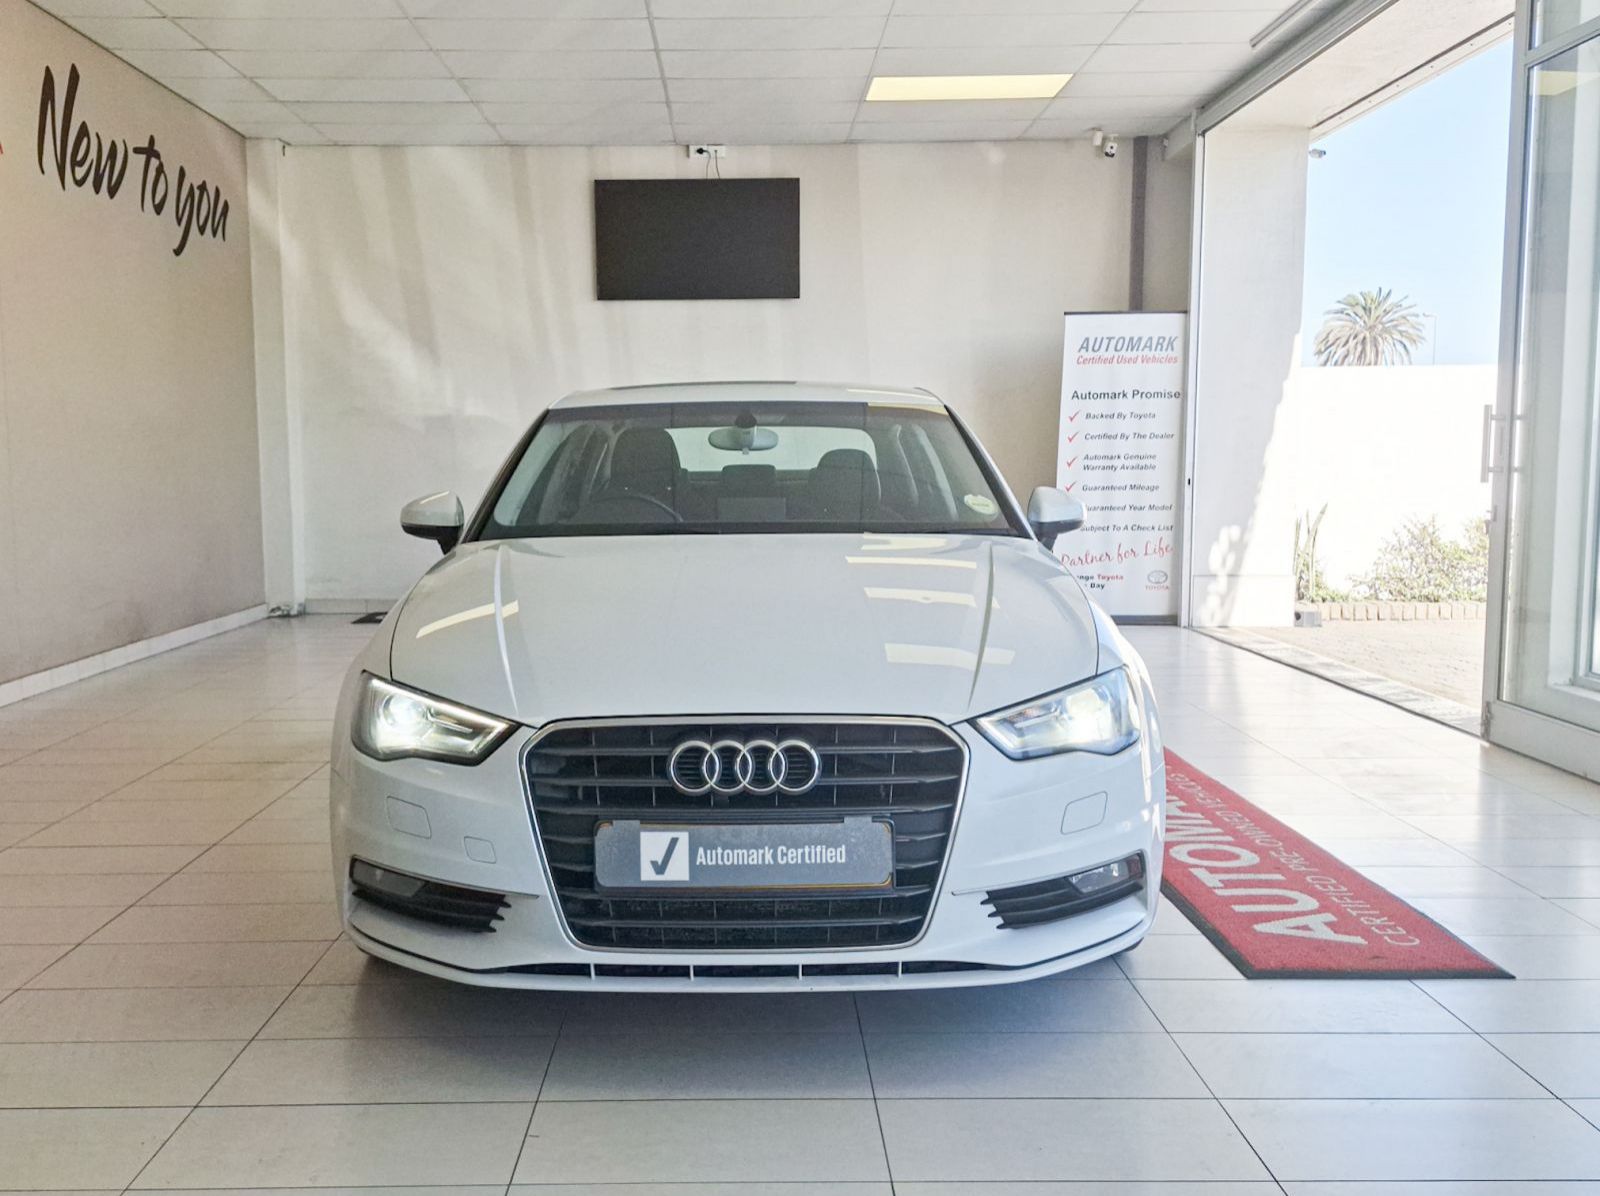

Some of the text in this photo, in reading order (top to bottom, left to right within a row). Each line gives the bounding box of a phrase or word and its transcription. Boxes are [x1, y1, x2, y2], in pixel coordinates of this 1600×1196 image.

[37, 63, 229, 257] New to you
[1078, 336, 1178, 353] AUTOMARK
[1076, 354, 1178, 365] Certified Used Vehicles
[1071, 389, 1181, 400] Automark Promise
[1117, 413, 1126, 421] By
[1129, 412, 1156, 420] Toyota
[1084, 433, 1118, 441] Certified
[1120, 433, 1130, 441] By
[1150, 432, 1175, 440] Dealer
[1083, 453, 1157, 461] Automark Genuine
[1083, 463, 1157, 472] Warranty Available
[1082, 483, 1160, 492] Guaranteed Mileage
[1086, 504, 1126, 512] uaranteed
[1129, 504, 1146, 512] Year
[1112, 524, 1121, 532] To
[1123, 524, 1129, 532] A
[1131, 524, 1155, 532] Check
[1157, 524, 1174, 532] List
[1117, 542, 1138, 564] for
[1144, 535, 1174, 558] Life
[1097, 573, 1124, 581] Toyota
[696, 844, 846, 866] Automark Certified
[1305, 875, 1421, 947] CERTIFIED
